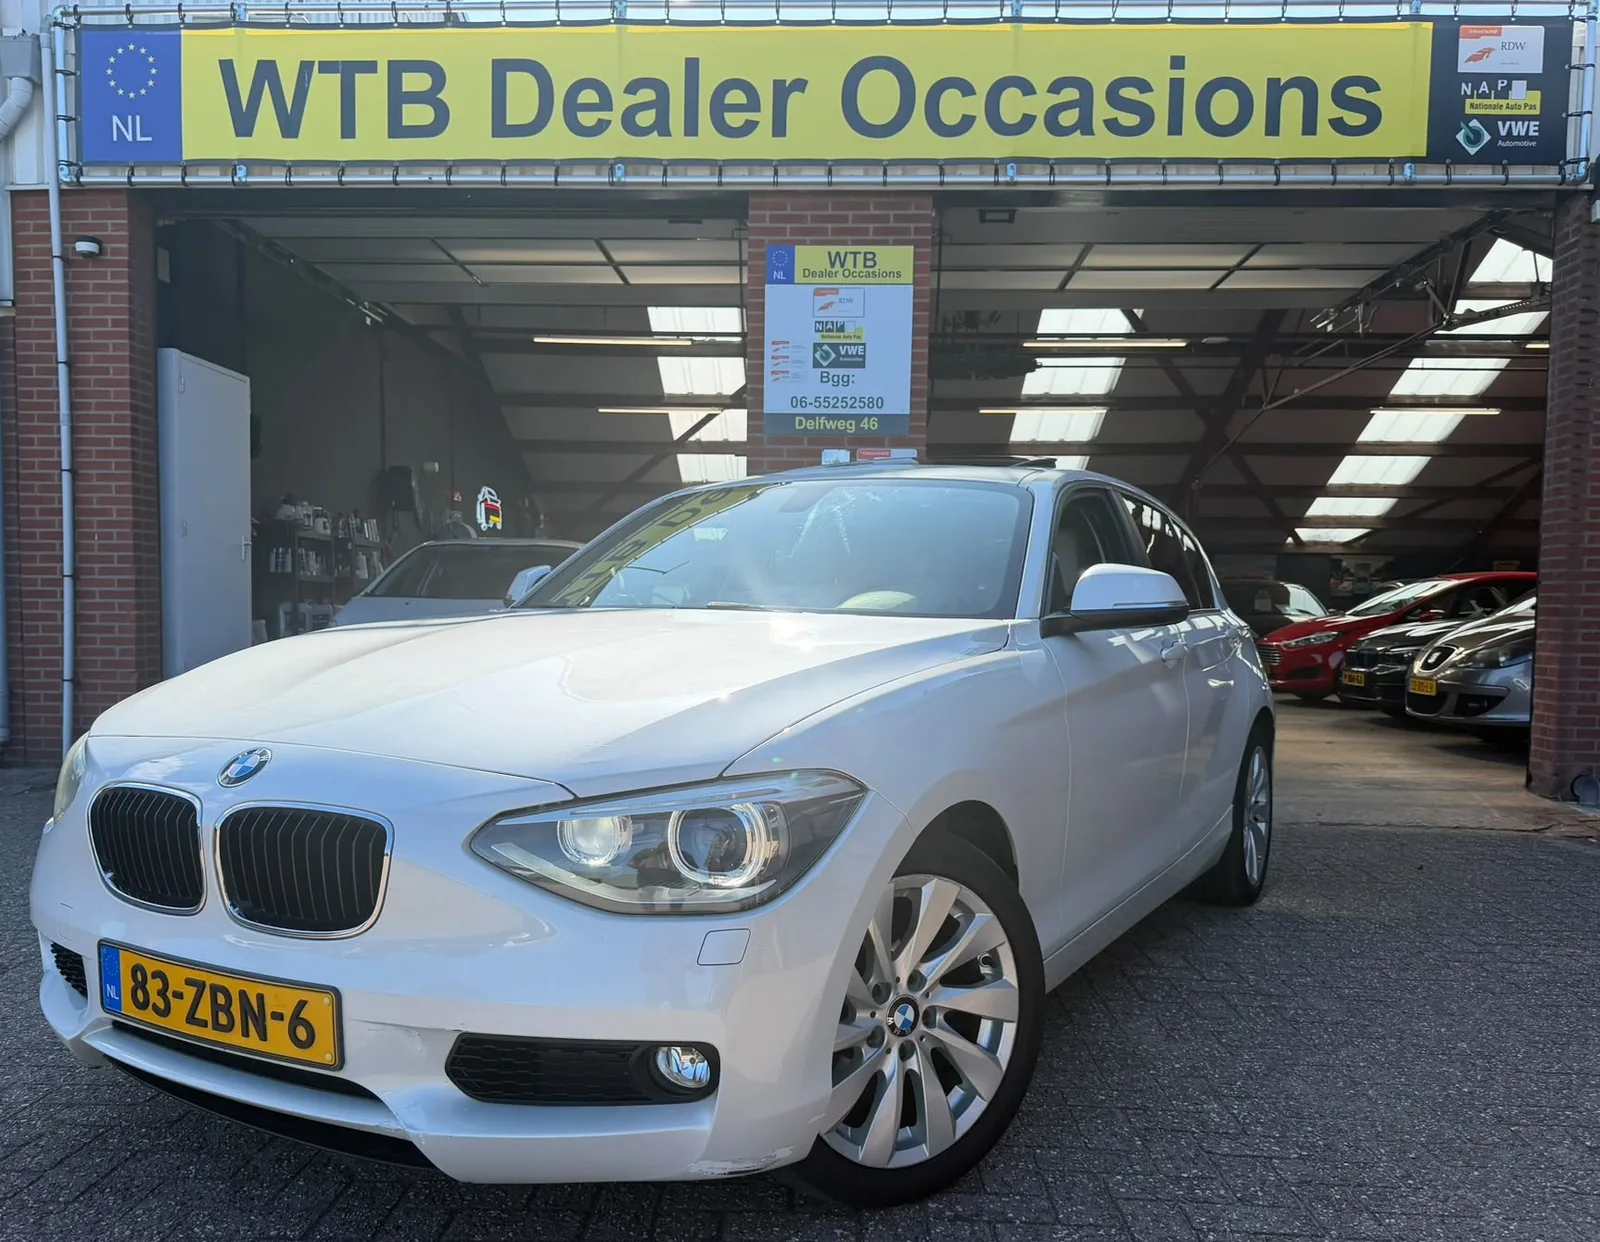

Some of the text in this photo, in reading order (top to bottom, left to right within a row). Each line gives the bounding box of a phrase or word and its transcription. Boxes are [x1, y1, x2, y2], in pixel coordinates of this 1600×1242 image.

[1501, 41, 1526, 51] RDW
[218, 55, 1384, 140] WTB Dealer Occasions
[1469, 102, 1537, 111] Nationale Auto Pas
[111, 115, 153, 142] NL
[1497, 121, 1540, 136] VWE
[827, 251, 878, 268] WTB
[773, 270, 786, 280] NL
[802, 268, 902, 279] Dealer Occasions
[839, 345, 864, 355] VWE
[820, 371, 855, 387] Bgg:
[790, 396, 884, 409] 06-55252580
[795, 416, 878, 432] Delfweg 46
[106, 983, 119, 1000] NL
[130, 962, 316, 1049] 83-ZBN-6
